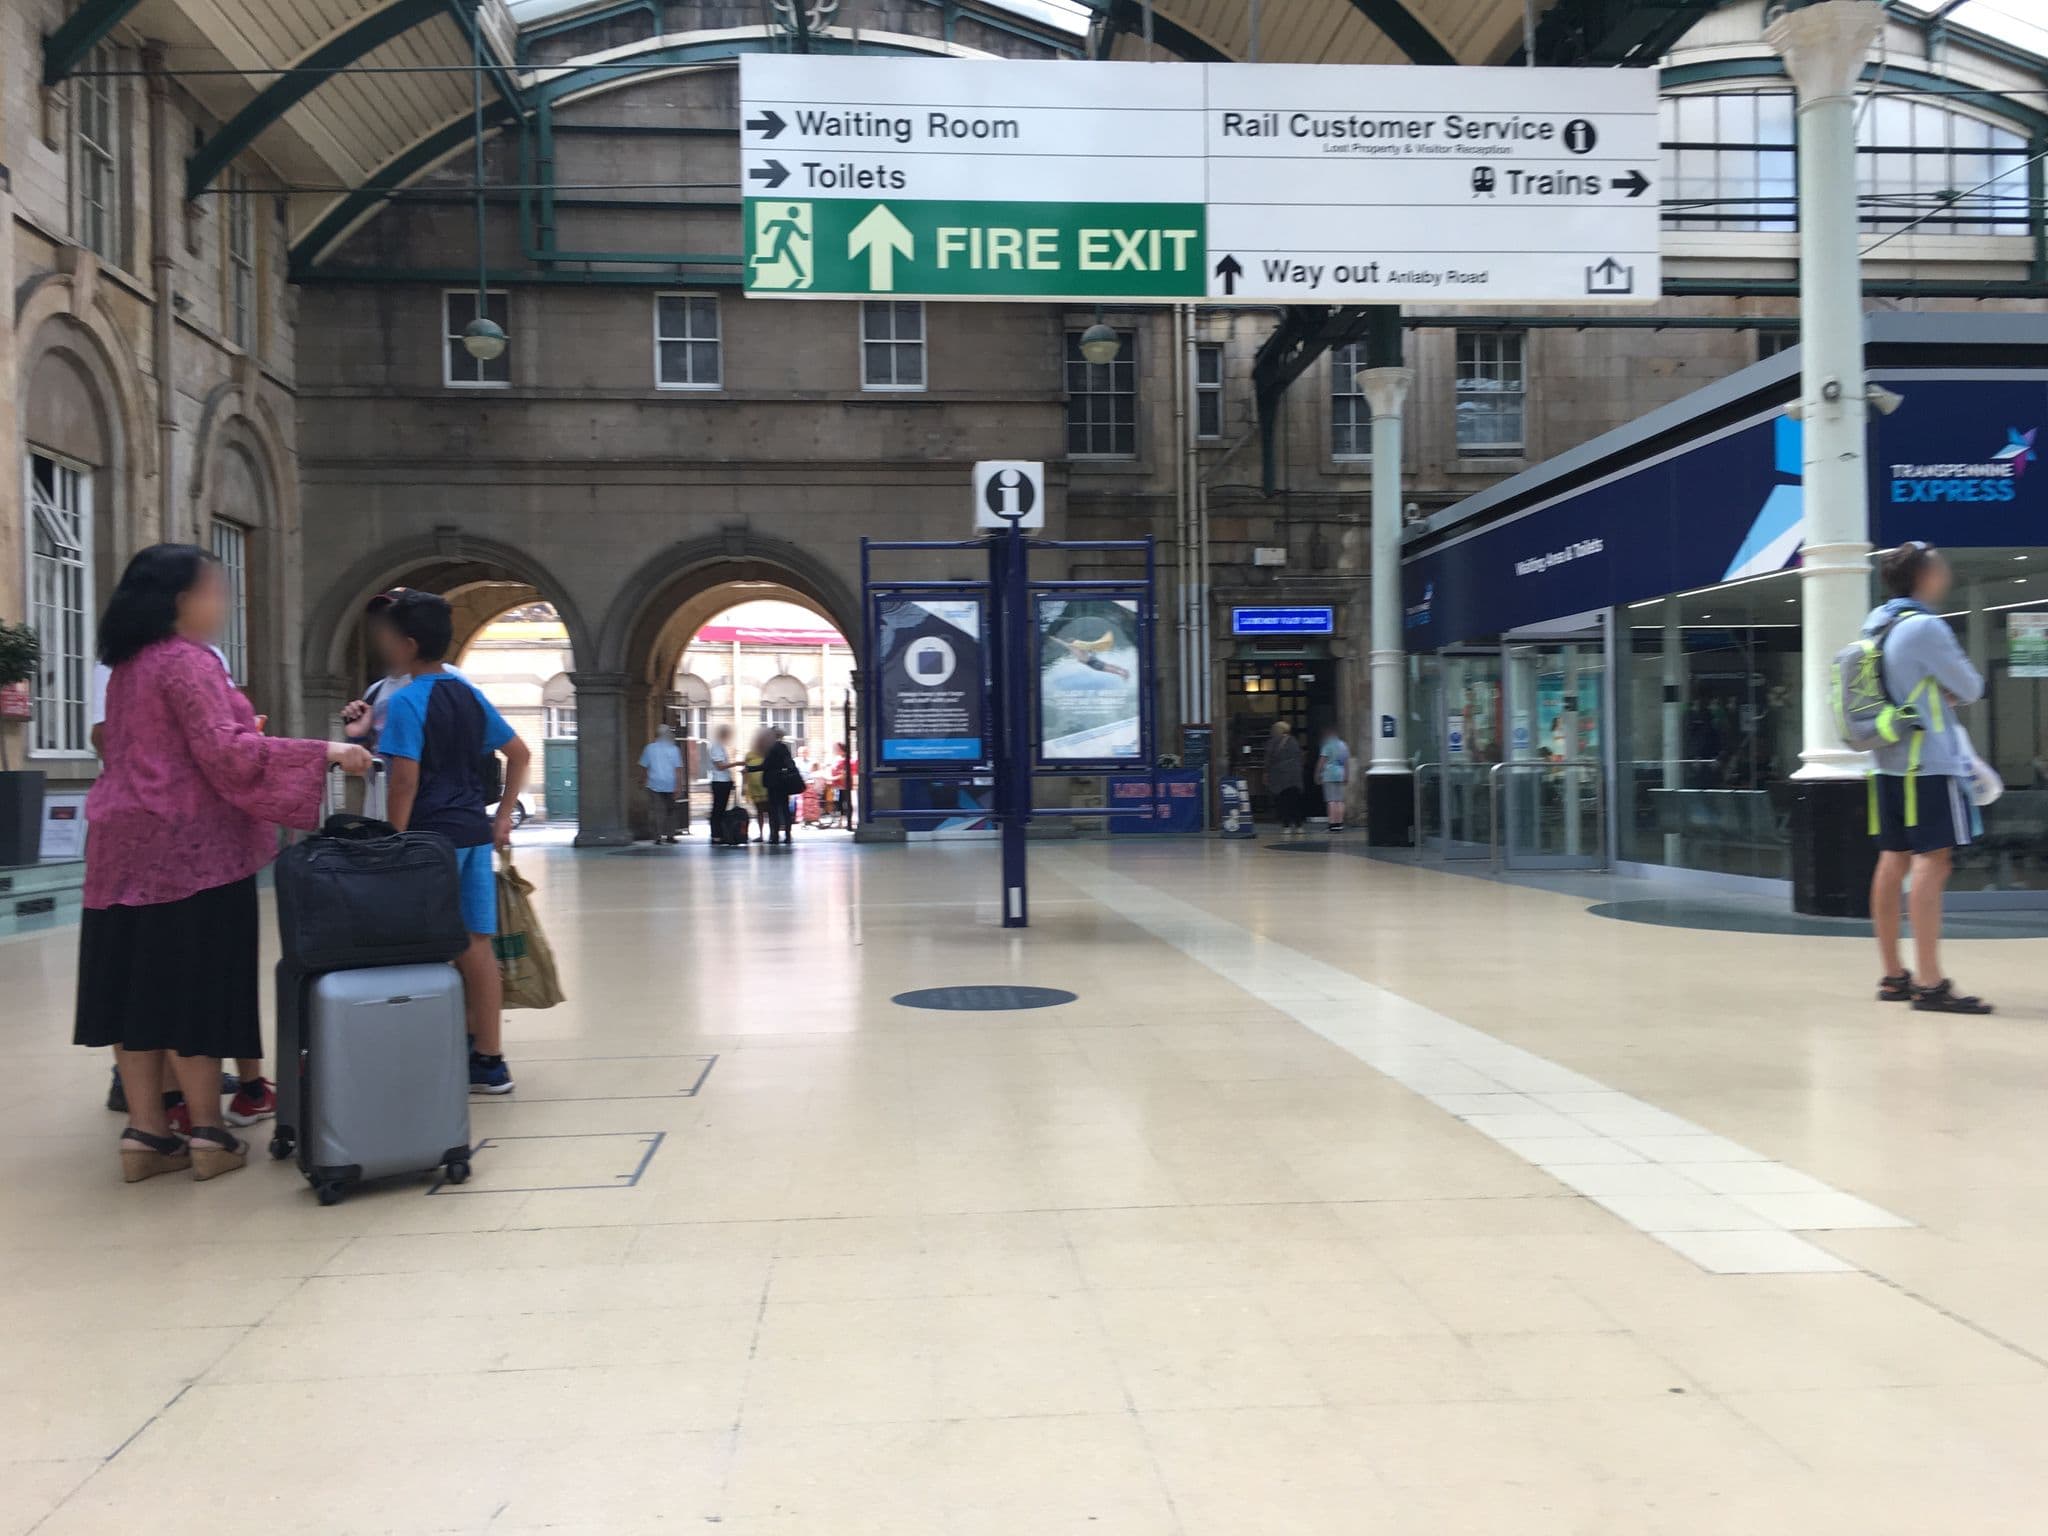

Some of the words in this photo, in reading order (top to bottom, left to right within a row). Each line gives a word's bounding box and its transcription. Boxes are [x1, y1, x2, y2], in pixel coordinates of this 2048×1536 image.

[797, 110, 911, 143] Waiting
[928, 112, 1019, 139] Room
[1222, 113, 1279, 139] Rail
[1289, 113, 1435, 140] Customer
[1444, 115, 1555, 141] Service
[1323, 143, 1350, 154] Lost
[1351, 143, 1401, 156] Property
[1403, 143, 1413, 154] &
[1415, 144, 1452, 155] Visitor
[1454, 144, 1513, 156] Reception
[802, 162, 906, 189] Toilets
[1505, 169, 1602, 196] Trains
[936, 227, 1061, 270] FIRE
[1078, 229, 1198, 271] EXIT
[1262, 260, 1324, 289] Way
[1333, 261, 1380, 284] out
[1387, 269, 1442, 285] Anlaby
[1446, 270, 1488, 284] Road
[1889, 463, 2015, 478] TRANSPENNINE
[1890, 479, 2017, 503] EXPRESS
